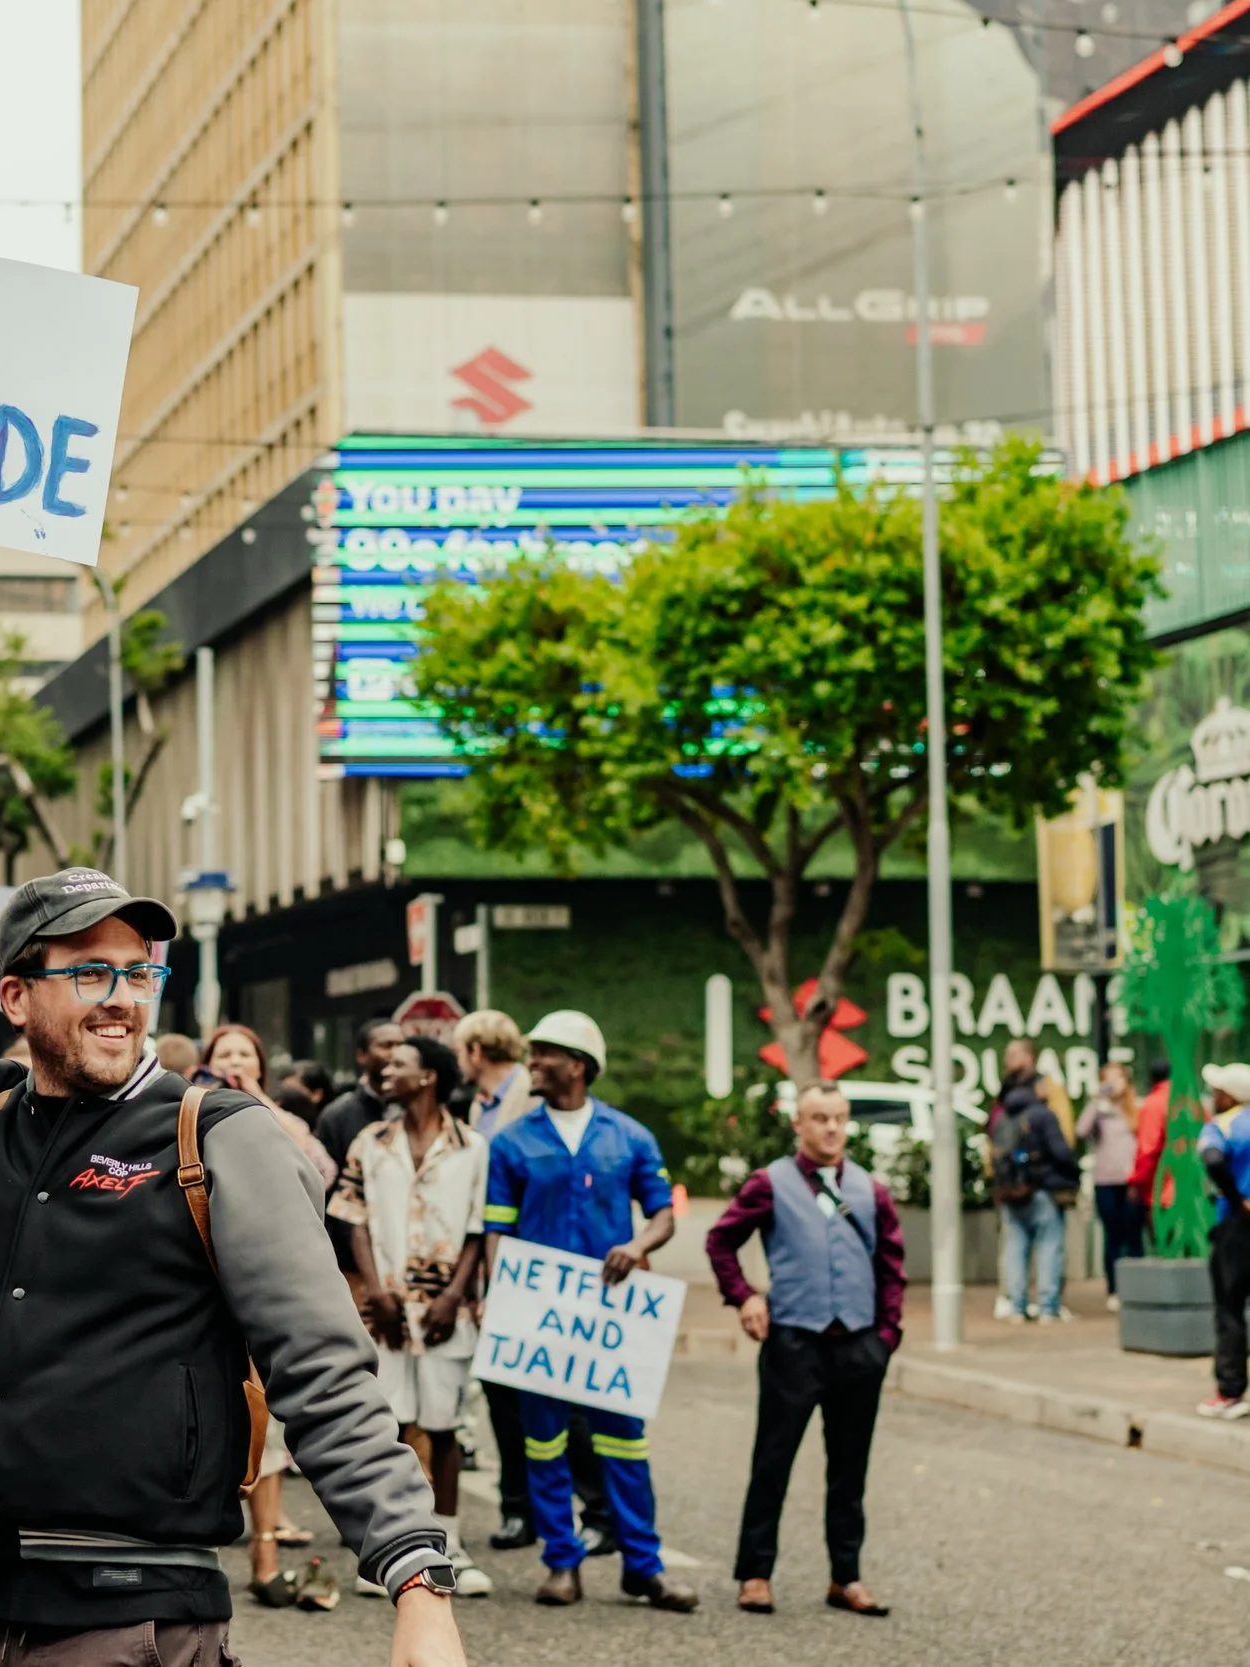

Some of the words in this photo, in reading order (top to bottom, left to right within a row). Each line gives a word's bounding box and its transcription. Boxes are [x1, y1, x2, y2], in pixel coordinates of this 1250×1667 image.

[90, 1154, 129, 1171] BEVERLY
[129, 1162, 153, 1172] HILLS
[108, 1167, 129, 1177] COP
[497, 1256, 665, 1320] NETFLIX
[537, 1307, 623, 1350] AND
[488, 1332, 632, 1400] TJAILA
